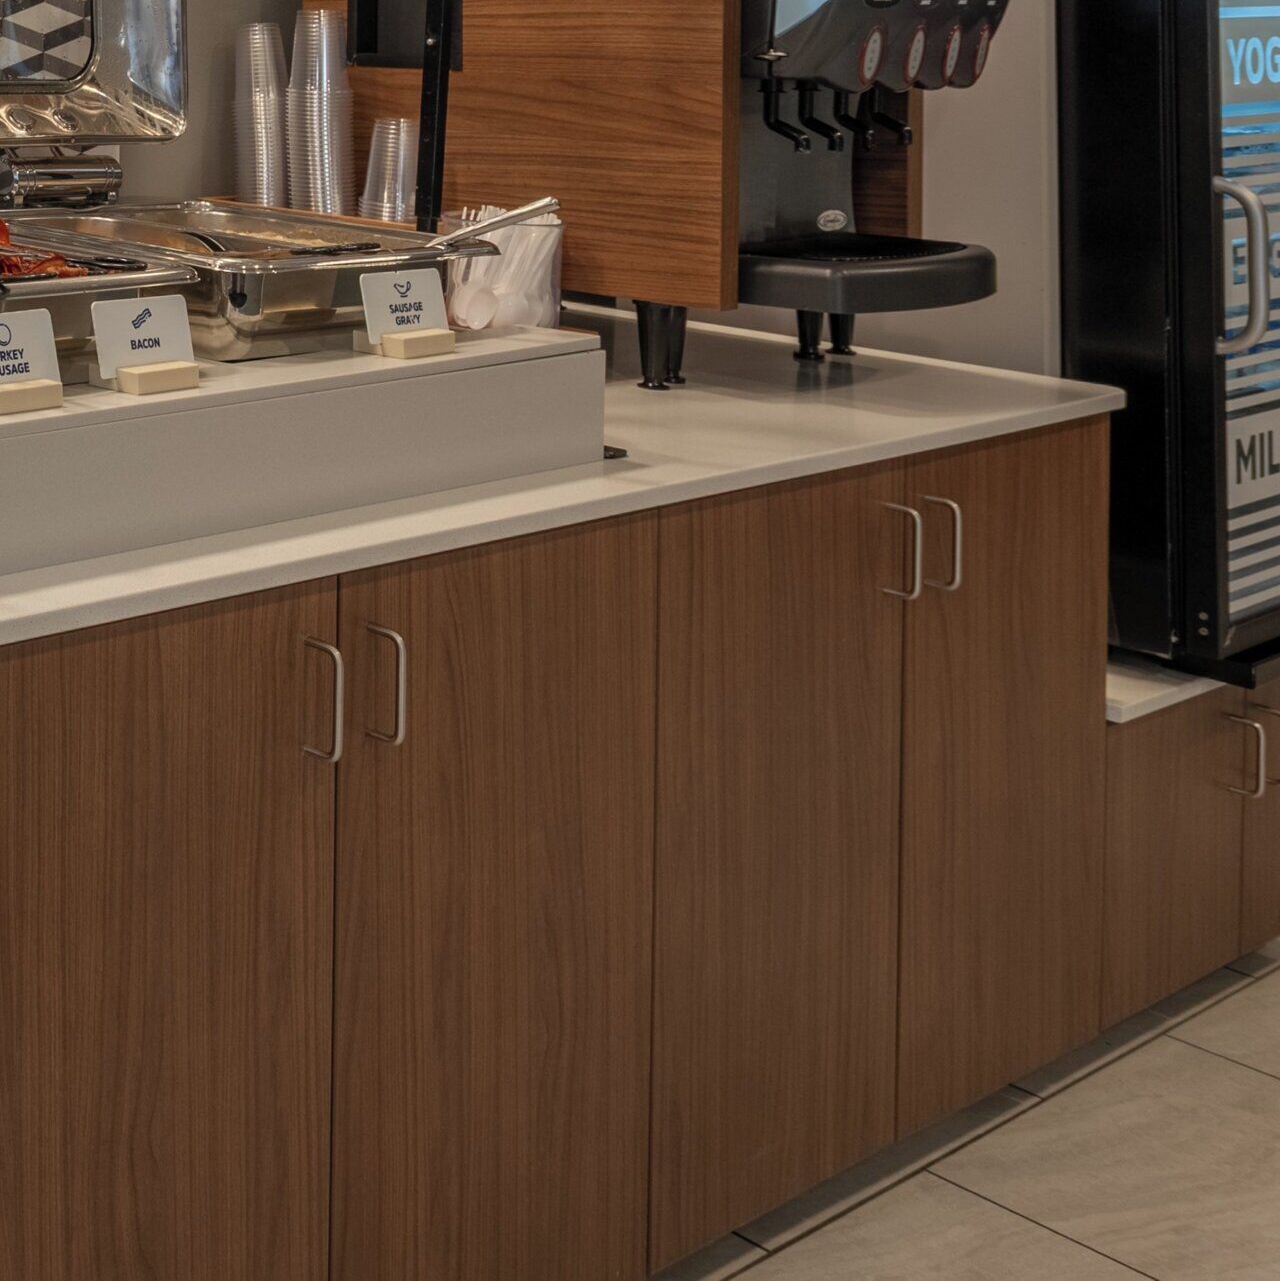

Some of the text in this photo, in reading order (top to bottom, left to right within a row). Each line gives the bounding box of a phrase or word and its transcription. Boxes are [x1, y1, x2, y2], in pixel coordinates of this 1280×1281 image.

[1226, 36, 1280, 85] YOG
[389, 301, 424, 314] SAUSAGE
[395, 314, 421, 326] GRAVY
[130, 337, 161, 350] BACON
[1235, 430, 1280, 485] MIL
